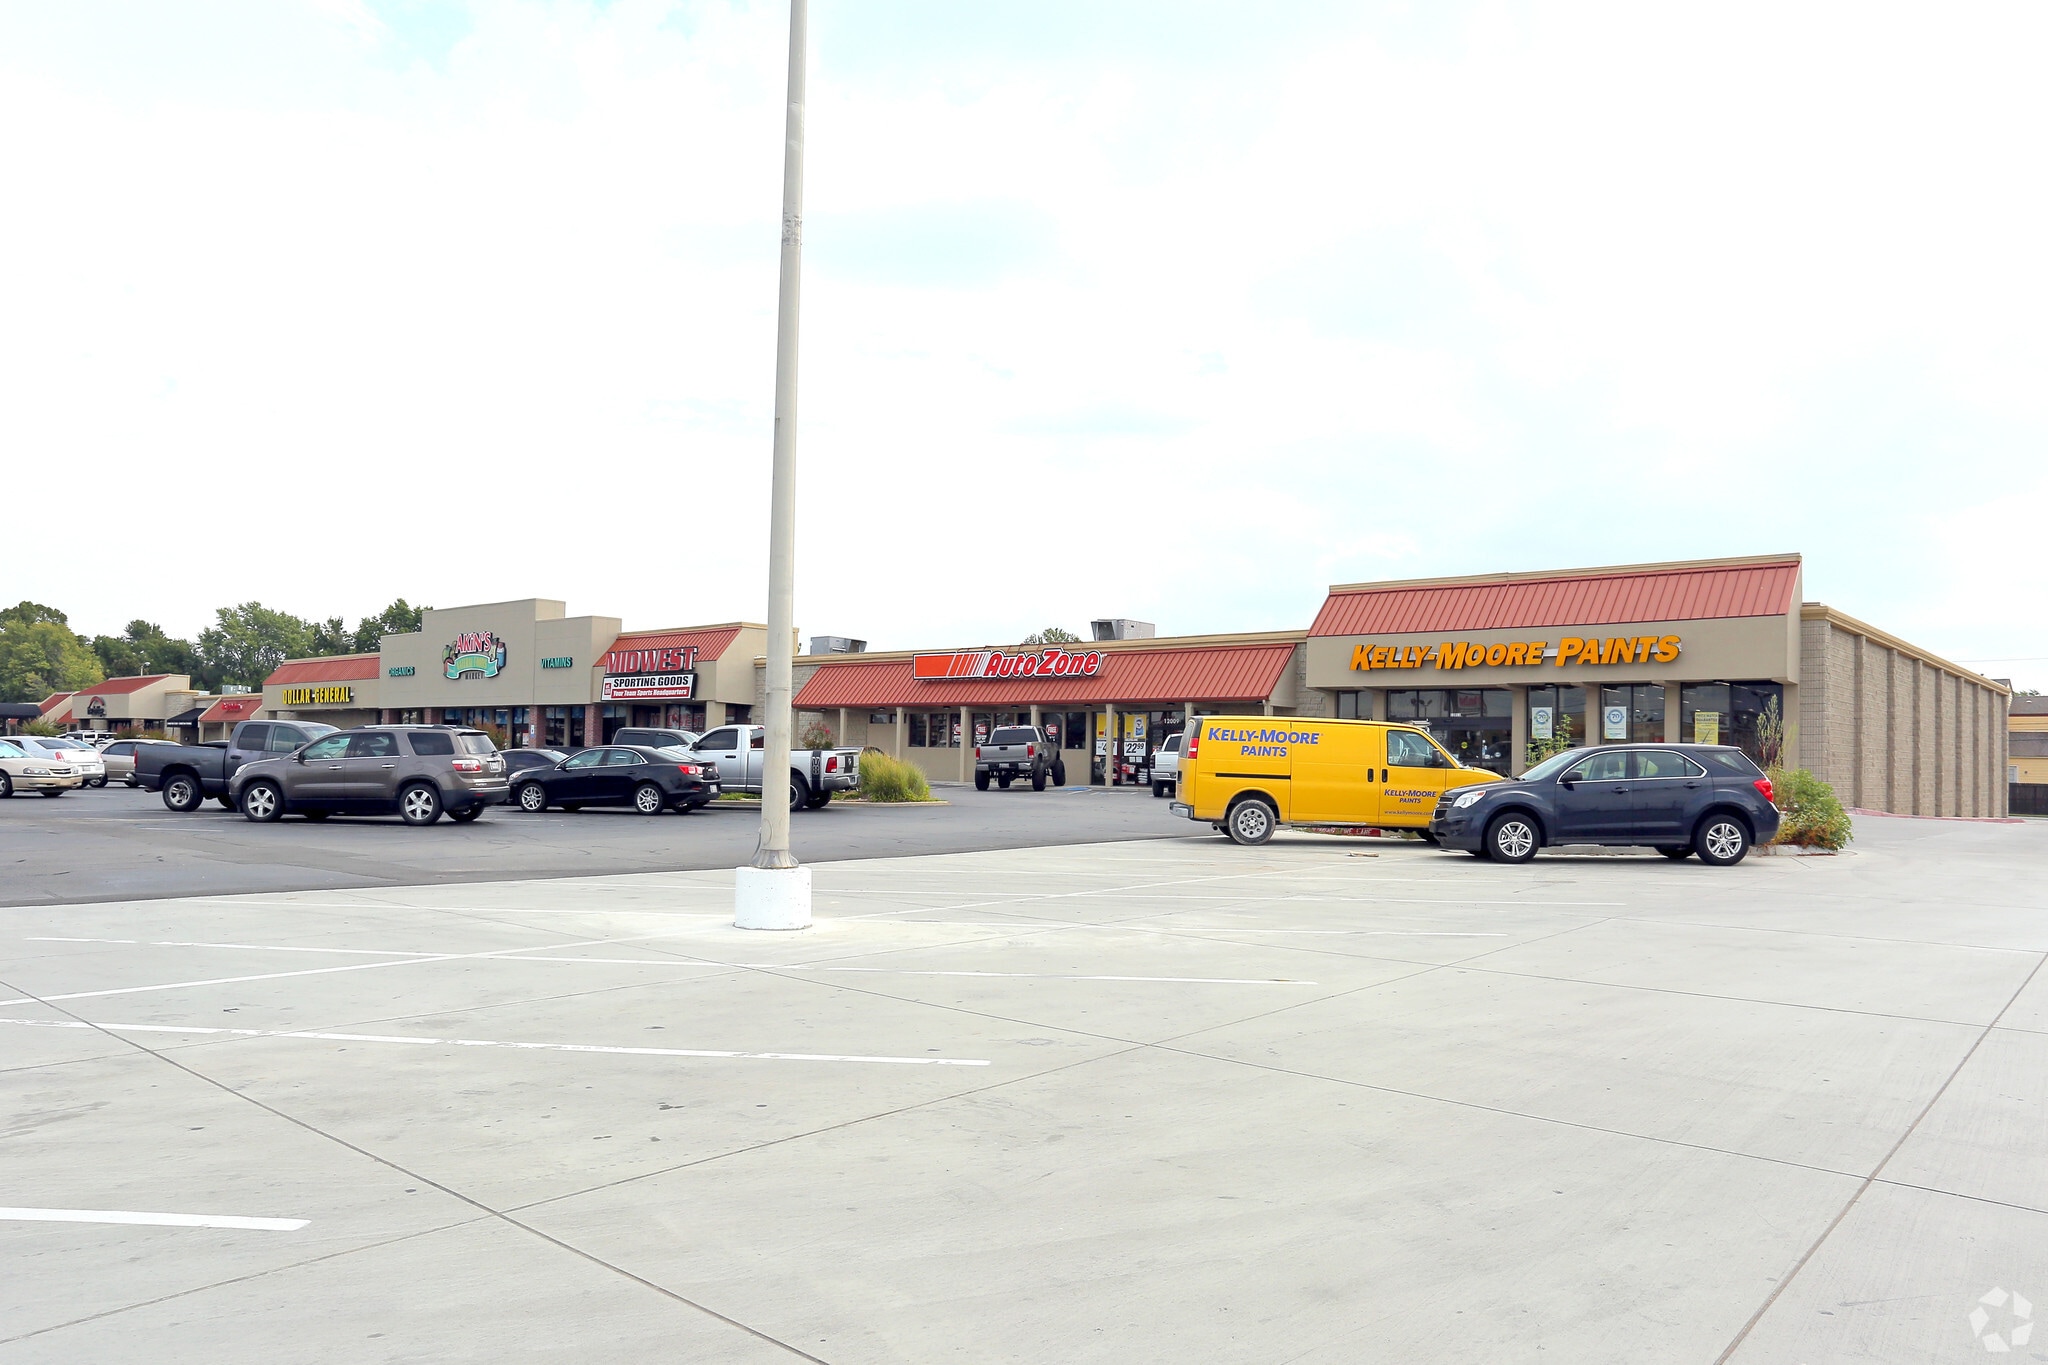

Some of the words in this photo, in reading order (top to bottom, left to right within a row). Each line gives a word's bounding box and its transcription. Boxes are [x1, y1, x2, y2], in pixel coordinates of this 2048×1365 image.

[605, 646, 698, 674] MIDWEST
[1349, 641, 1548, 671] KELLY-MOORE
[1554, 635, 1682, 667] PAINTS
[541, 657, 573, 669] VITAMINS
[981, 650, 1100, 677] AutoZone
[613, 677, 657, 688] SPORTING
[657, 675, 689, 687] GOODS
[282, 688, 312, 705] DOLLAR
[314, 686, 351, 704] GENERAL
[636, 689, 653, 697] Sports
[1208, 727, 1320, 745] KELLY-MOORE
[1240, 745, 1287, 757] PAINTS
[1384, 788, 1437, 798] KELLY-MOORE
